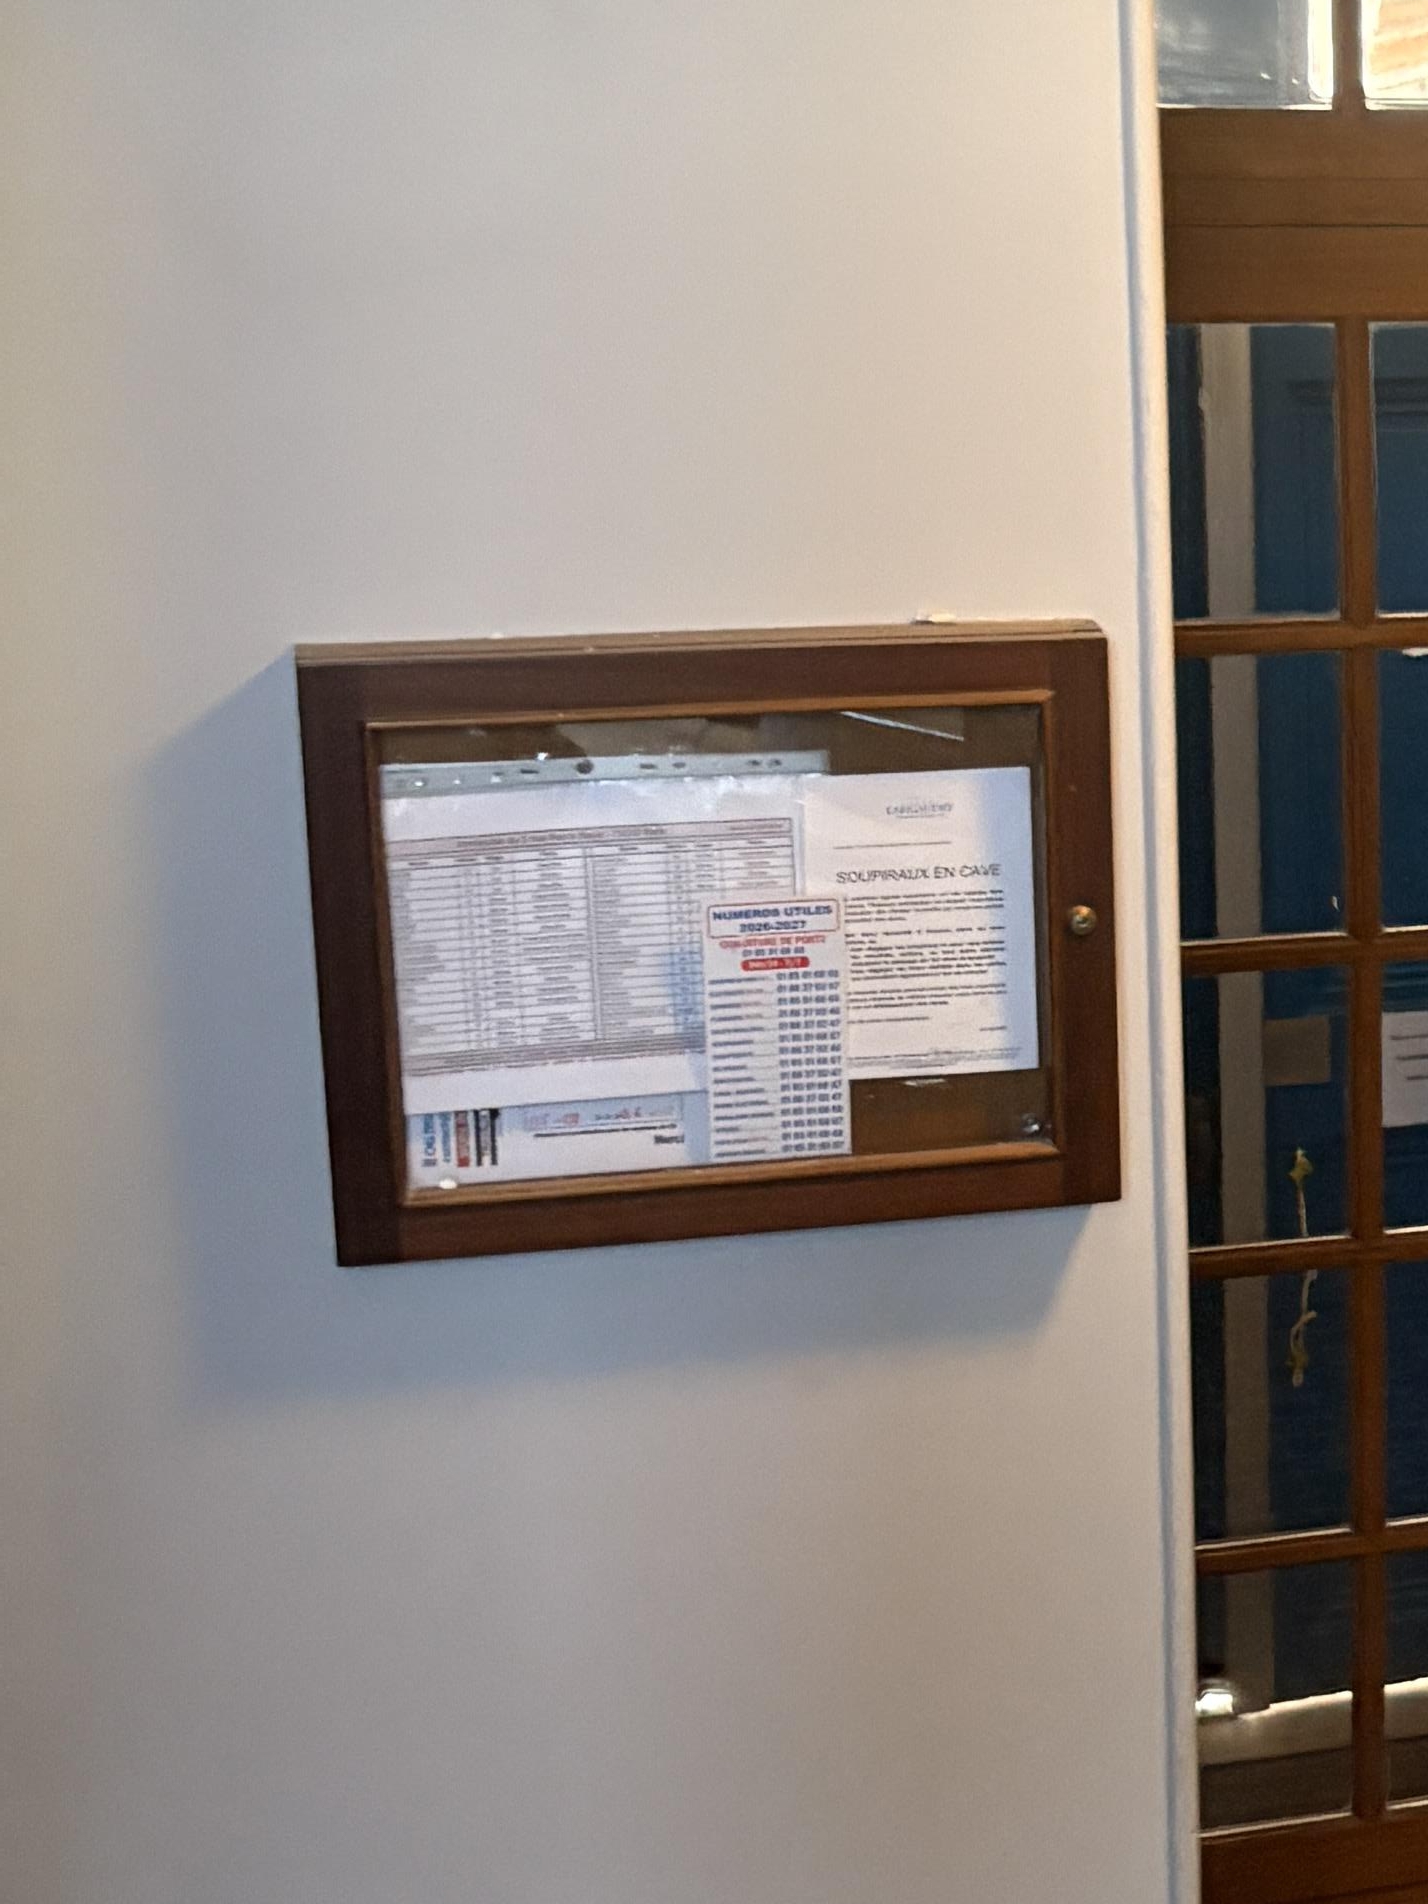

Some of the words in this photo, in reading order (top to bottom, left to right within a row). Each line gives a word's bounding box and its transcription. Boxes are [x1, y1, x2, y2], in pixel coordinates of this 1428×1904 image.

[836, 868, 929, 884] SOUPIRAUX
[934, 866, 955, 879] EN
[959, 863, 1002, 878] CAVE
[713, 908, 780, 921] NUMEROS
[784, 905, 832, 917] UTILES
